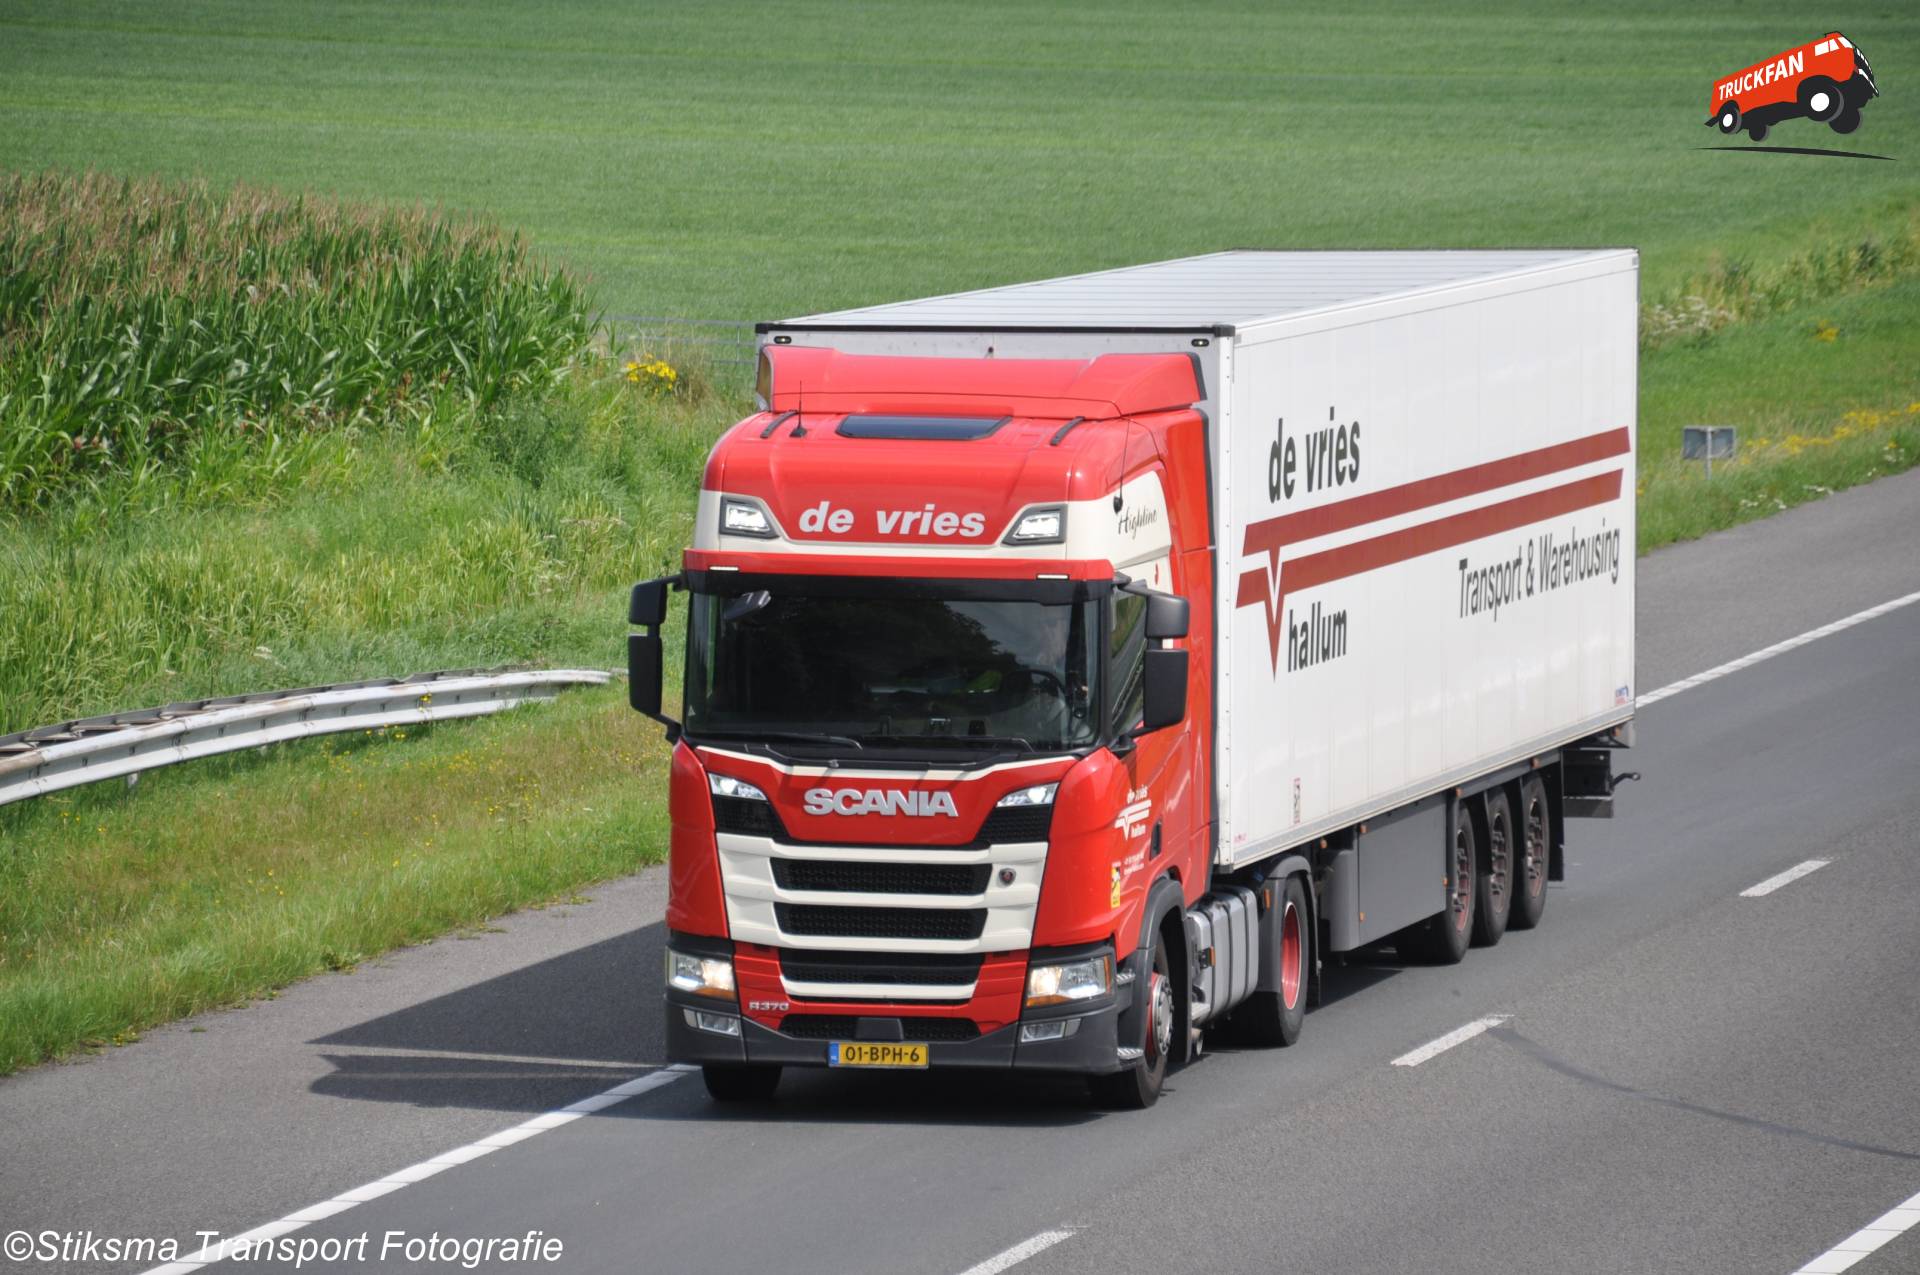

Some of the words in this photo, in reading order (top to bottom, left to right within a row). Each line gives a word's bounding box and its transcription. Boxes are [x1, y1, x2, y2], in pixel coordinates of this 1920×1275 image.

[1268, 417, 1297, 504] de
[1305, 405, 1361, 493] vries
[798, 500, 855, 534] de
[876, 503, 986, 537] vries
[1458, 545, 1523, 622] Transport
[1525, 538, 1535, 598] &
[1539, 517, 1621, 593] Warehousing
[1287, 601, 1347, 673] hallum
[803, 787, 959, 817] SCANIA
[748, 1001, 790, 1011] R370
[845, 1046, 920, 1062] 01-BPH-6
